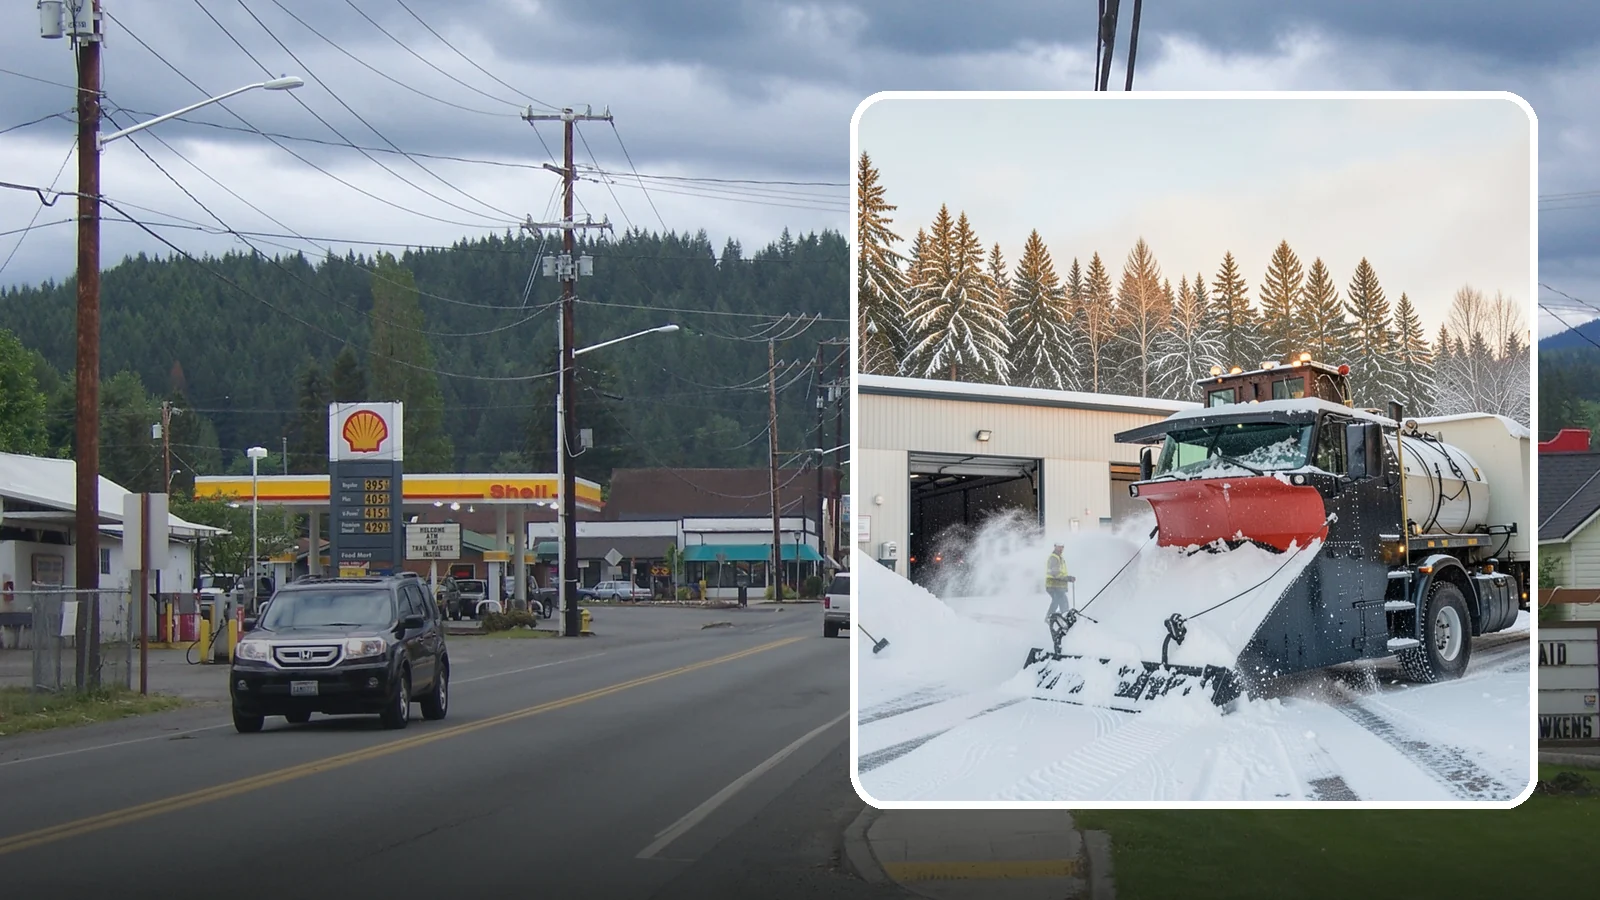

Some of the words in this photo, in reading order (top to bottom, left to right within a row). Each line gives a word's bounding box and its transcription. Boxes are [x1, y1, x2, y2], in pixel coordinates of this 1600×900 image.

[366, 480, 383, 490] 395
[490, 484, 547, 499] Shell
[366, 494, 383, 504] 405
[366, 508, 383, 518] 415
[366, 522, 383, 532] 429
